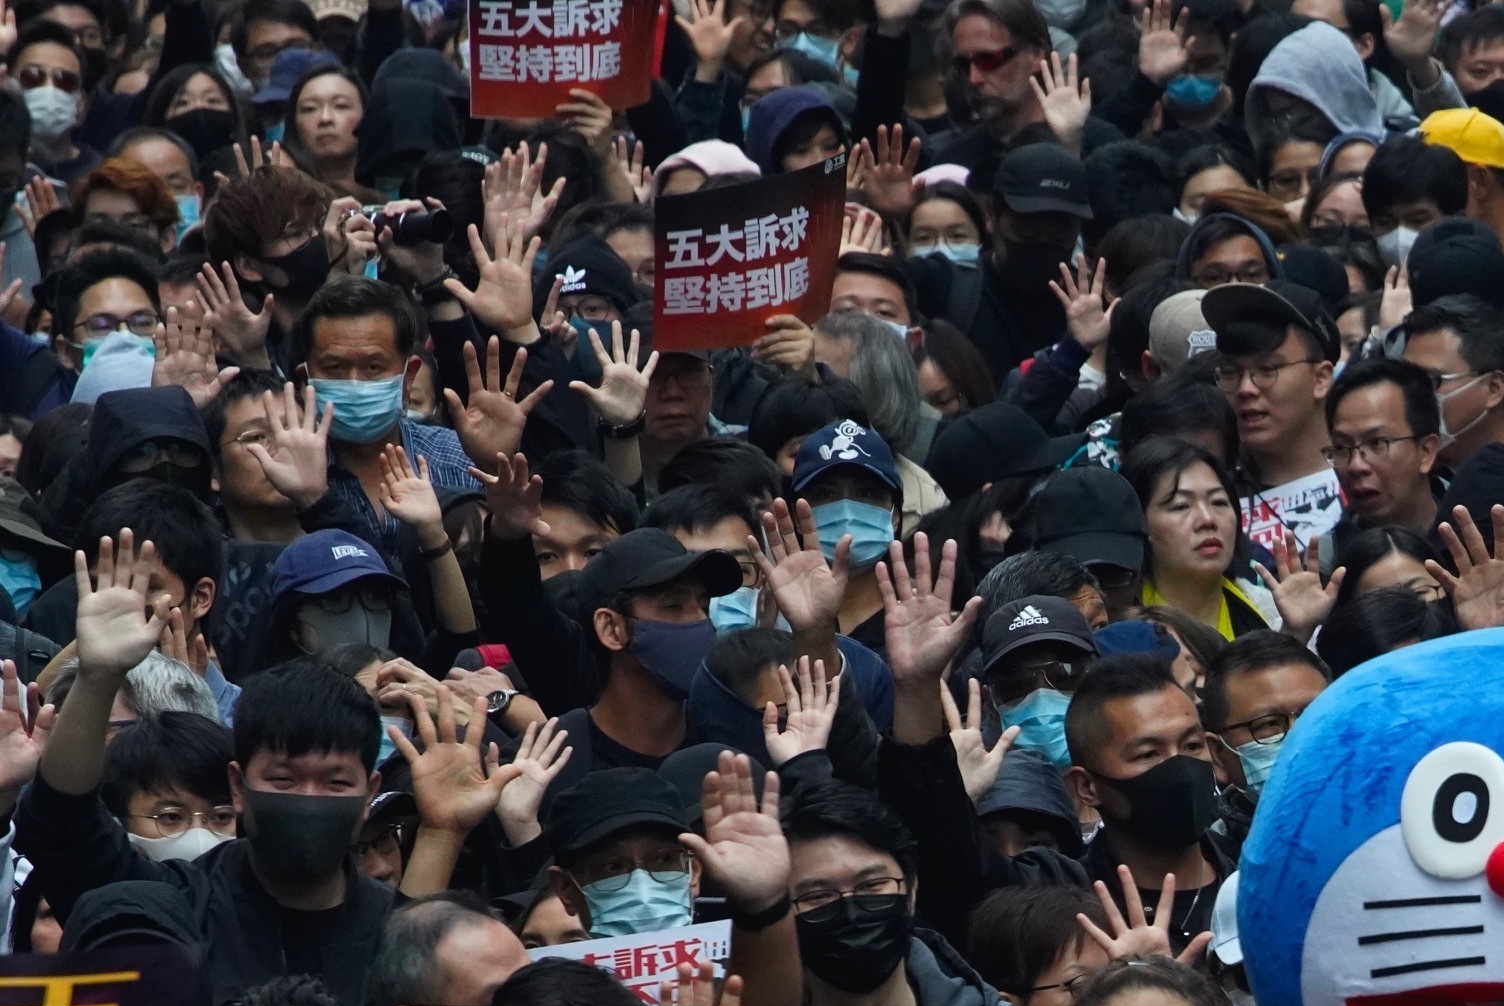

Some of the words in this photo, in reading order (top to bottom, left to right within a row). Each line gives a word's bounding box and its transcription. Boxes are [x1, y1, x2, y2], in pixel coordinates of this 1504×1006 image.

[478, 0, 624, 38] 五大訴求
[478, 40, 622, 83] 堅持到底
[664, 205, 810, 270] 五大訴求
[559, 281, 587, 293] didas
[662, 256, 810, 316] 堅持到底
[1008, 616, 1050, 631] adidas
